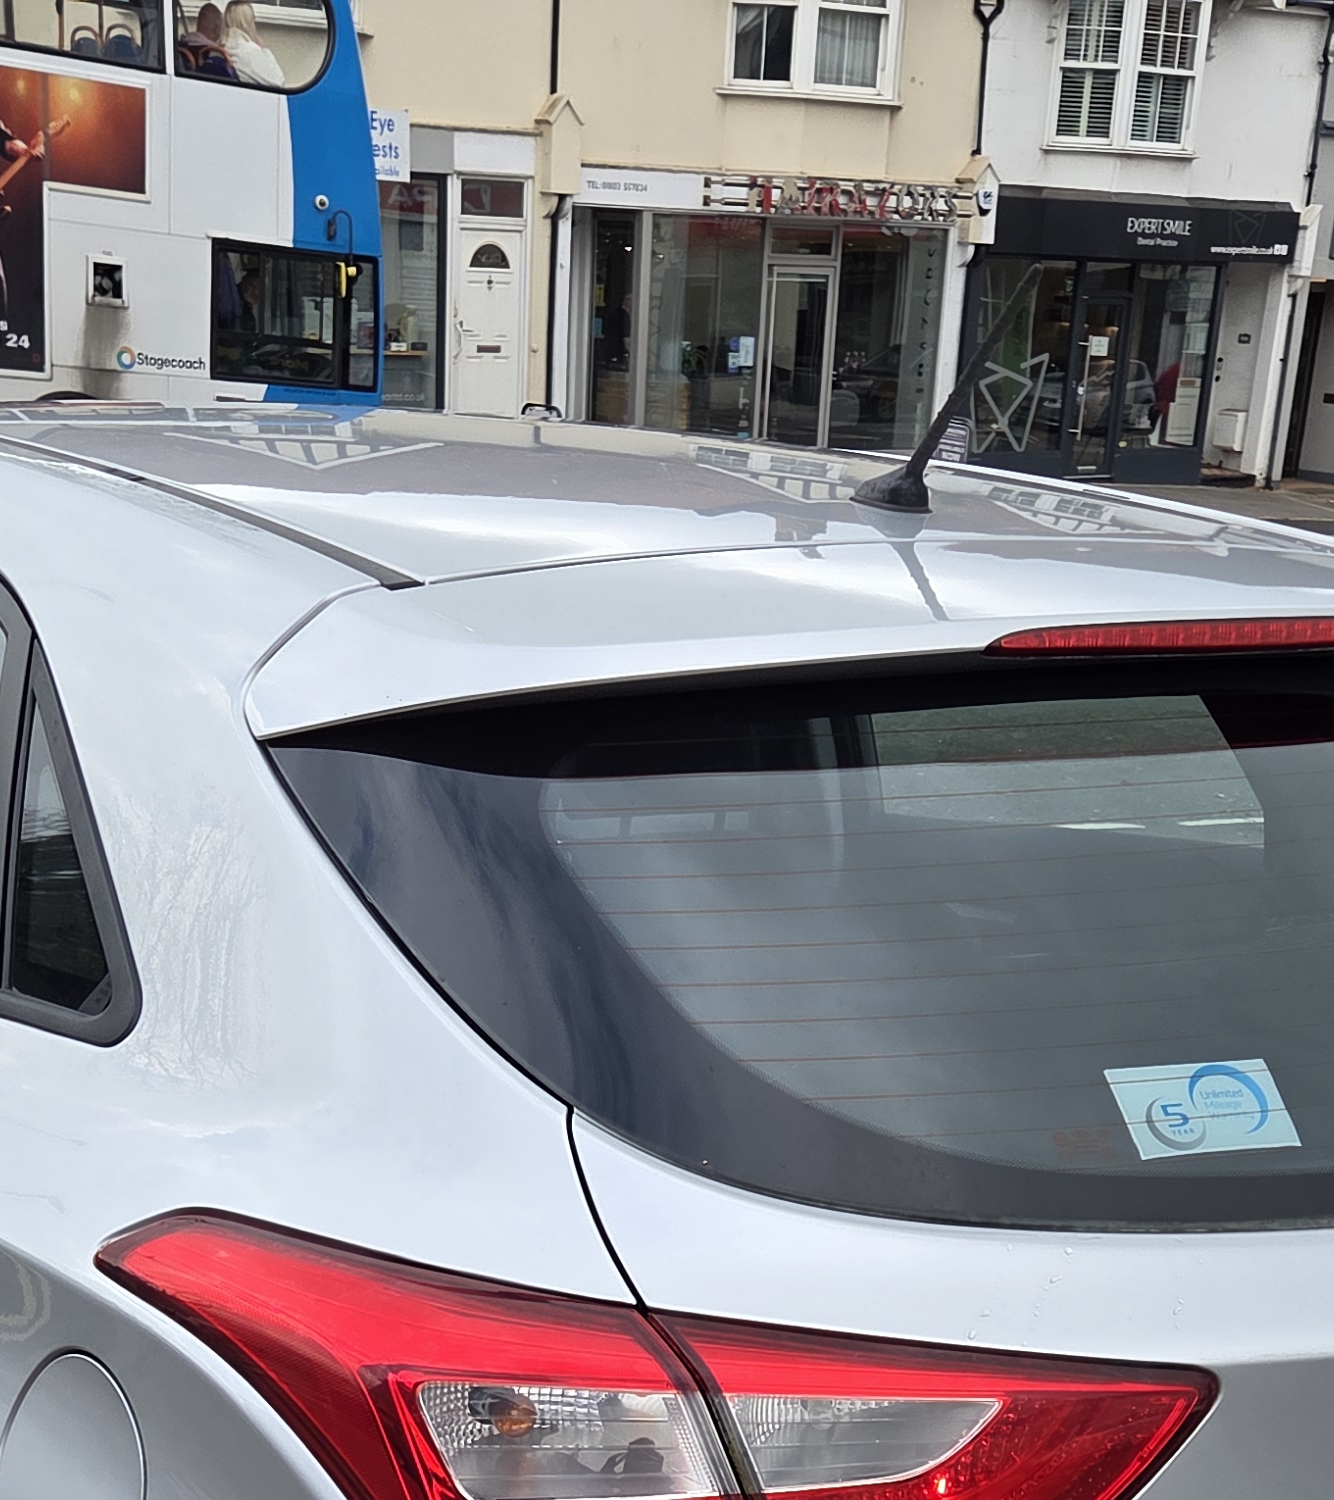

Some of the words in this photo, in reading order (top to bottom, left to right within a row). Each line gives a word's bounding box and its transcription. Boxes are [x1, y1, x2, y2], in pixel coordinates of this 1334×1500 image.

[370, 111, 395, 136] Eye
[373, 142, 400, 160] ests
[1127, 217, 1163, 234] EXPERT
[1164, 220, 1193, 235] SMILE
[5, 333, 30, 349] 24
[137, 352, 205, 371] Stagecoach
[1161, 1103, 1190, 1128] 5
[1171, 1127, 1195, 1137] YEAR
